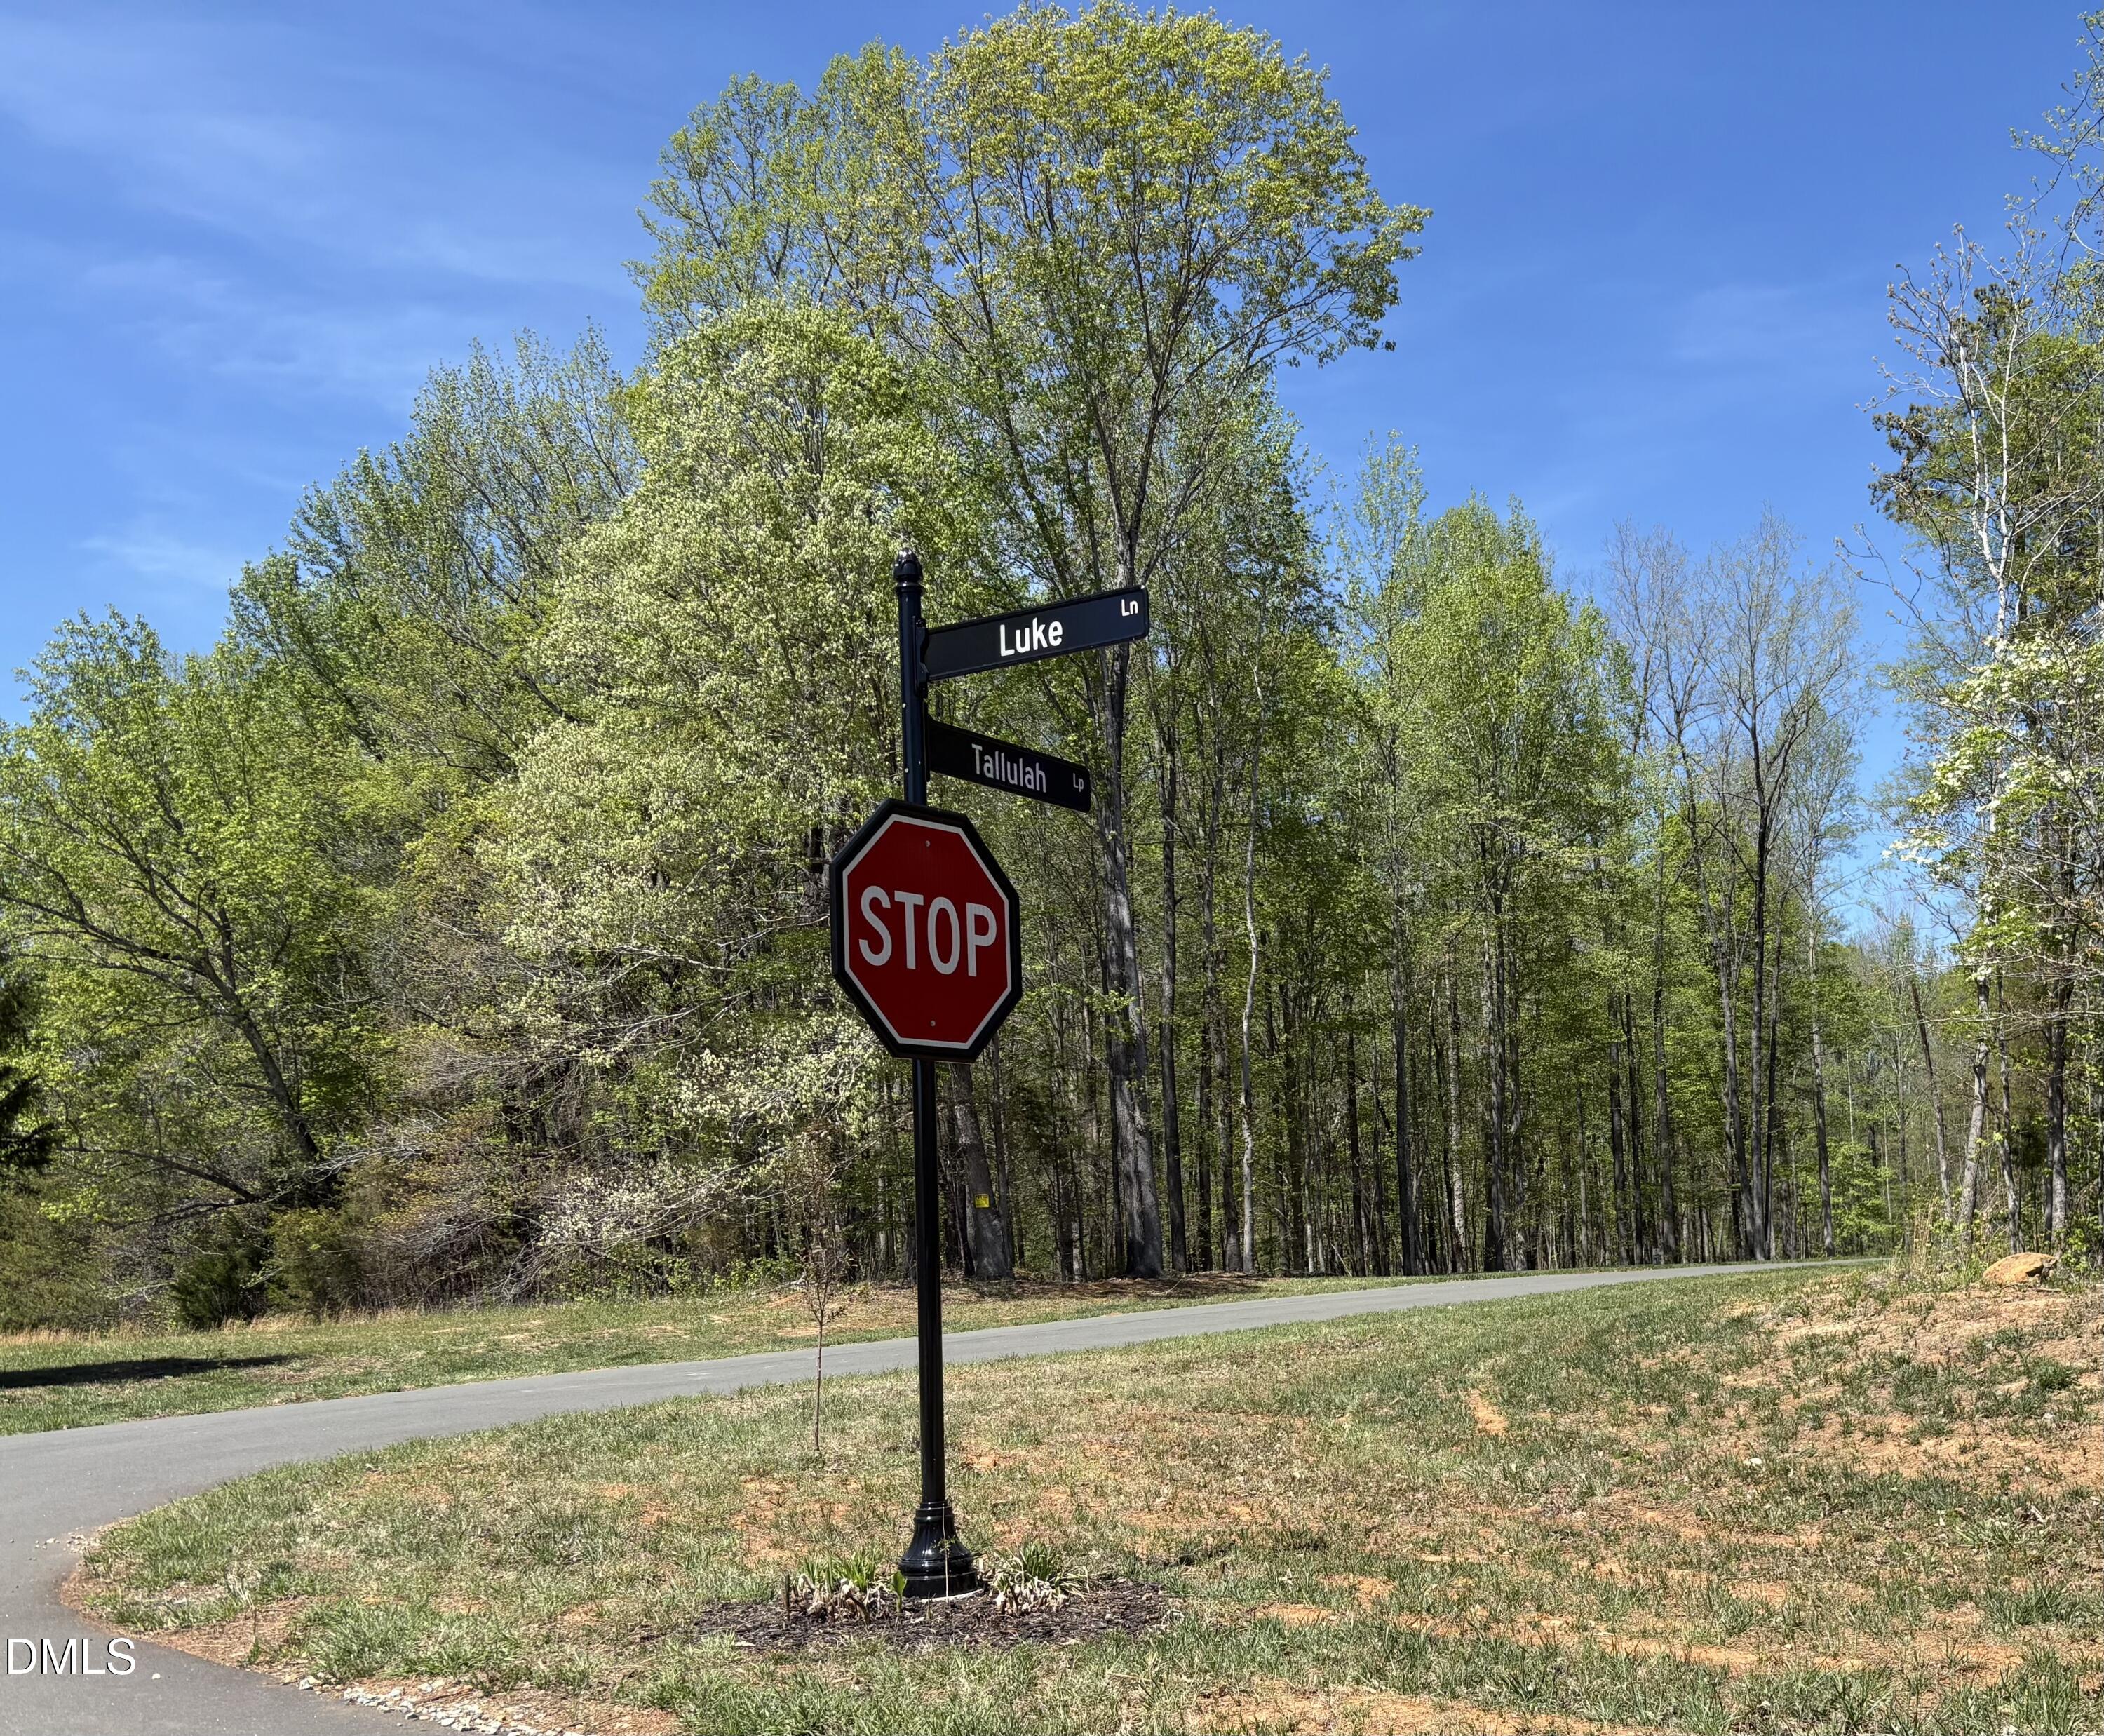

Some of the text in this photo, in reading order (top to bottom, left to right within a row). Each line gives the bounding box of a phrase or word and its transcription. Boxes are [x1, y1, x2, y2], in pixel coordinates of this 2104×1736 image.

[999, 598, 1139, 657] Luke Ln
[971, 743, 1084, 793] Tallulah Lp
[858, 885, 997, 977] STOP
